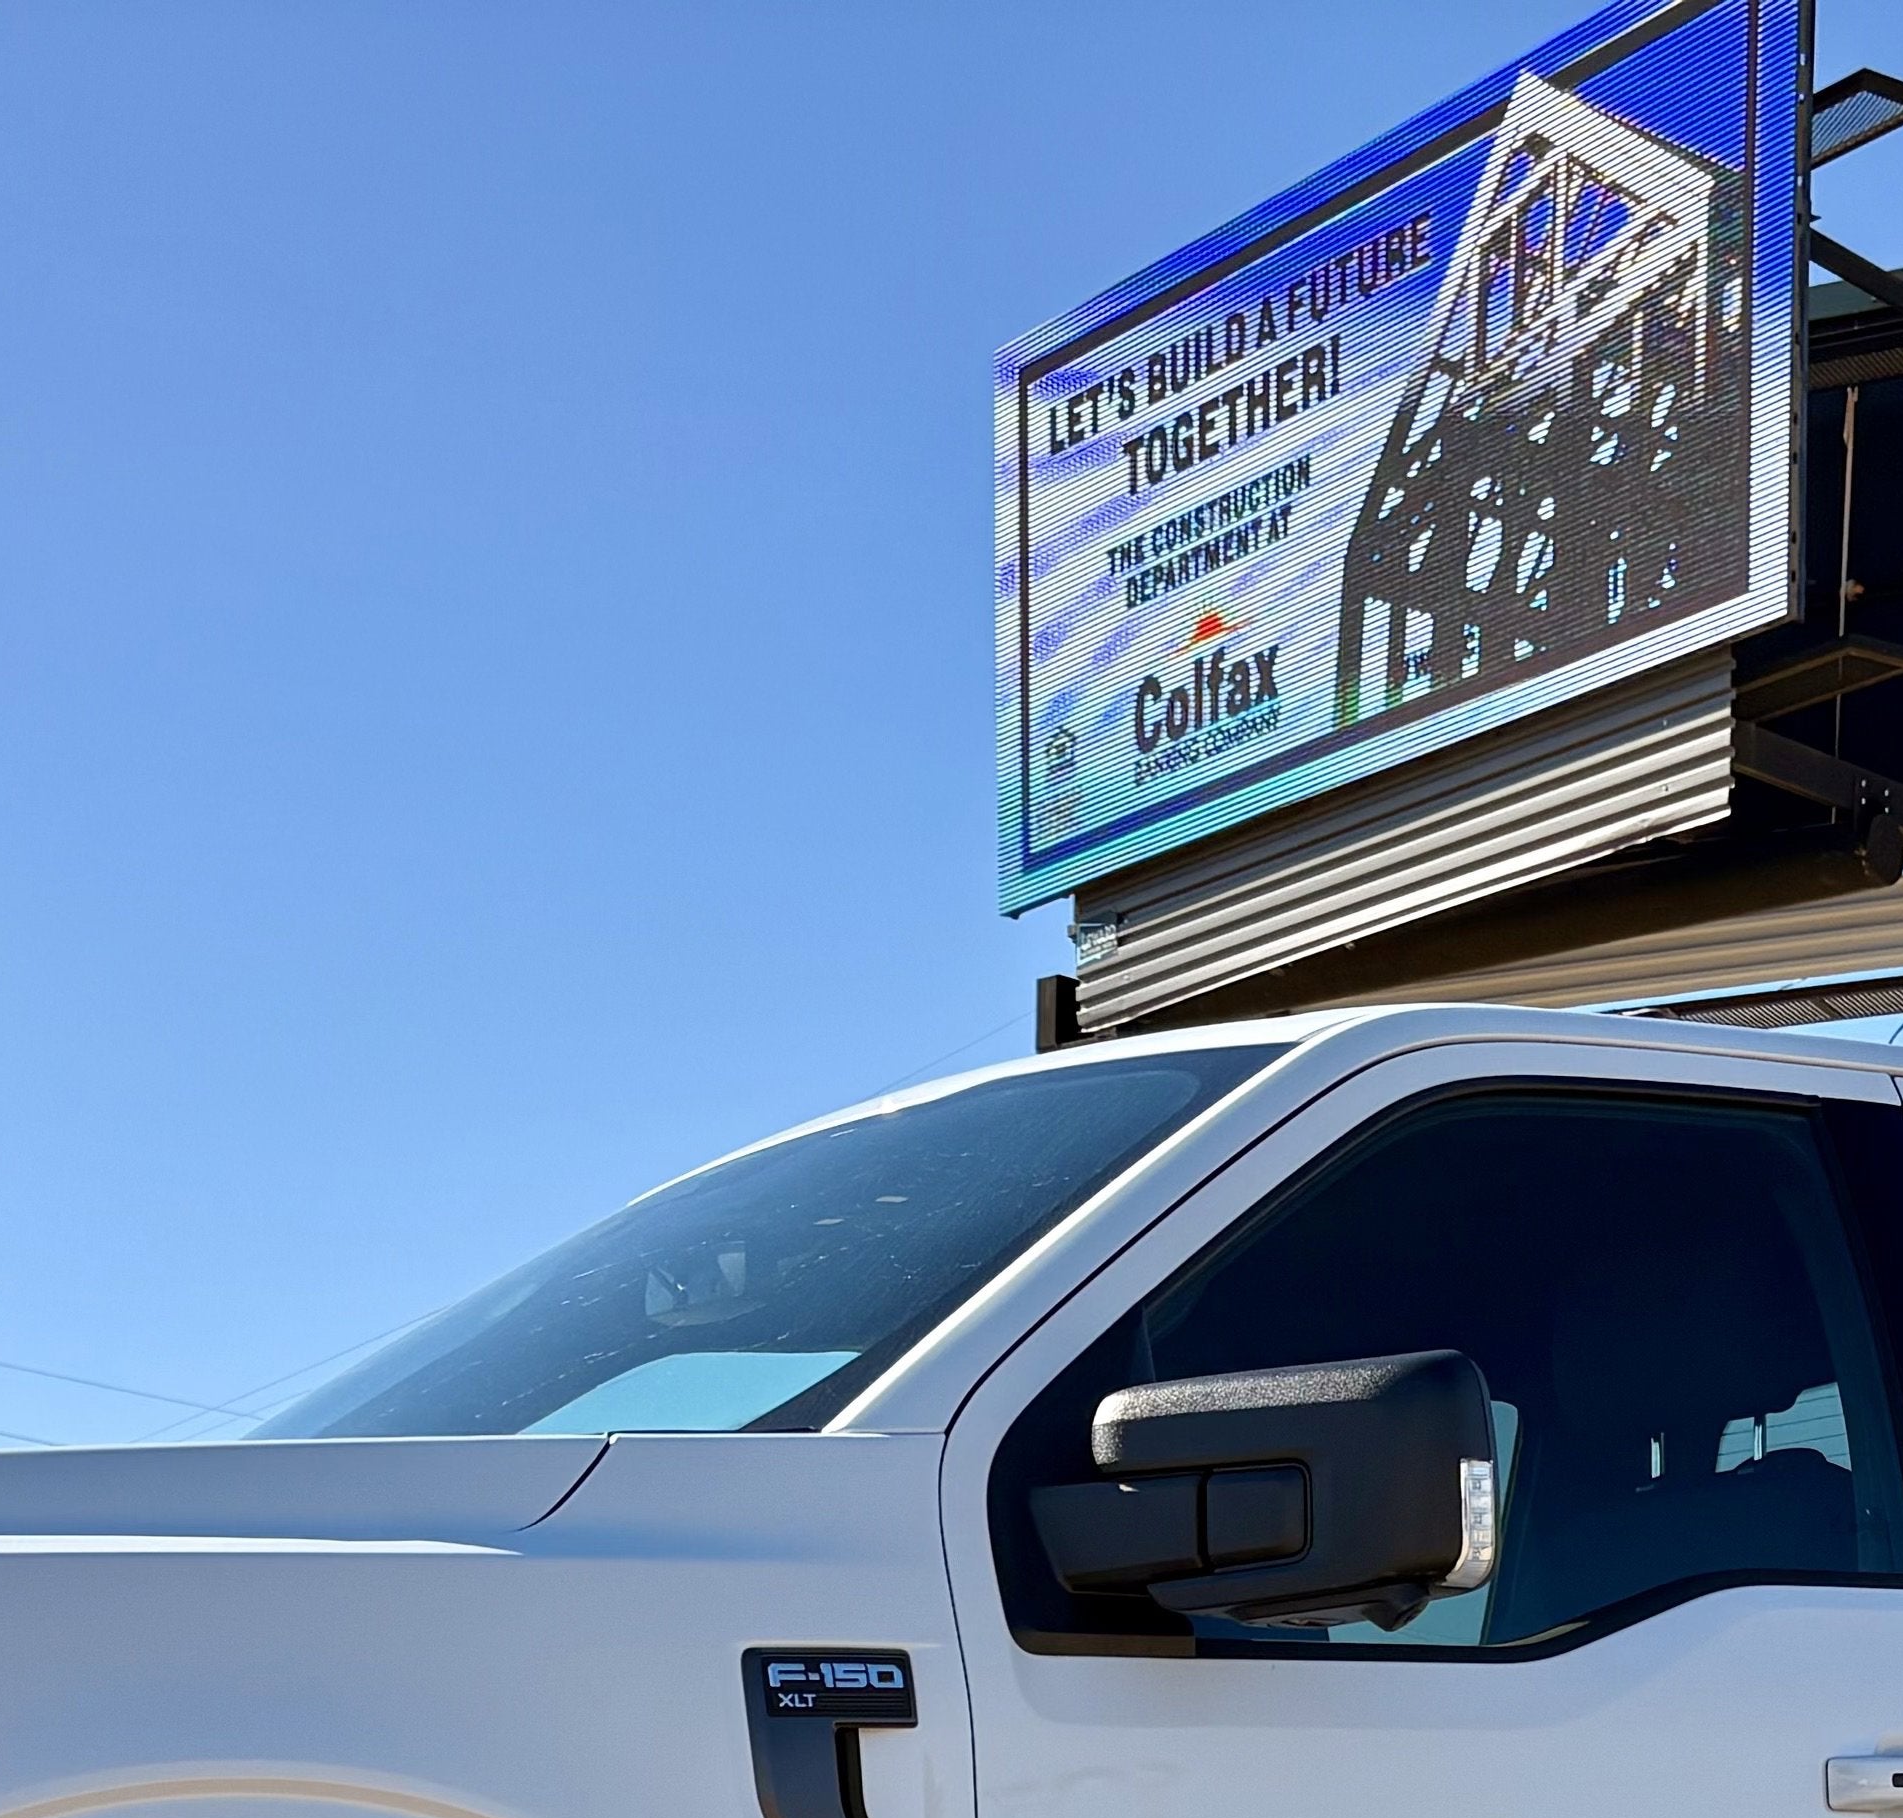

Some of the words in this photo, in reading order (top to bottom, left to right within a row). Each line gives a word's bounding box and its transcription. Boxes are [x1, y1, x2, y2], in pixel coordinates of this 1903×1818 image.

[1049, 368, 1137, 455] LET'S
[1147, 313, 1246, 405] BUILD
[1256, 297, 1277, 348] A
[1289, 211, 1433, 333] FUTURE
[1122, 334, 1341, 496] TOGETHER!
[1107, 531, 1147, 576] THE
[1151, 454, 1312, 556] CONSTRUCTION
[1126, 524, 1264, 609] DEPARTMENT
[1267, 505, 1293, 546] AT
[1135, 644, 1280, 754] Colfax
[767, 1662, 905, 1689] F-150
[777, 1693, 817, 1708] XLT
